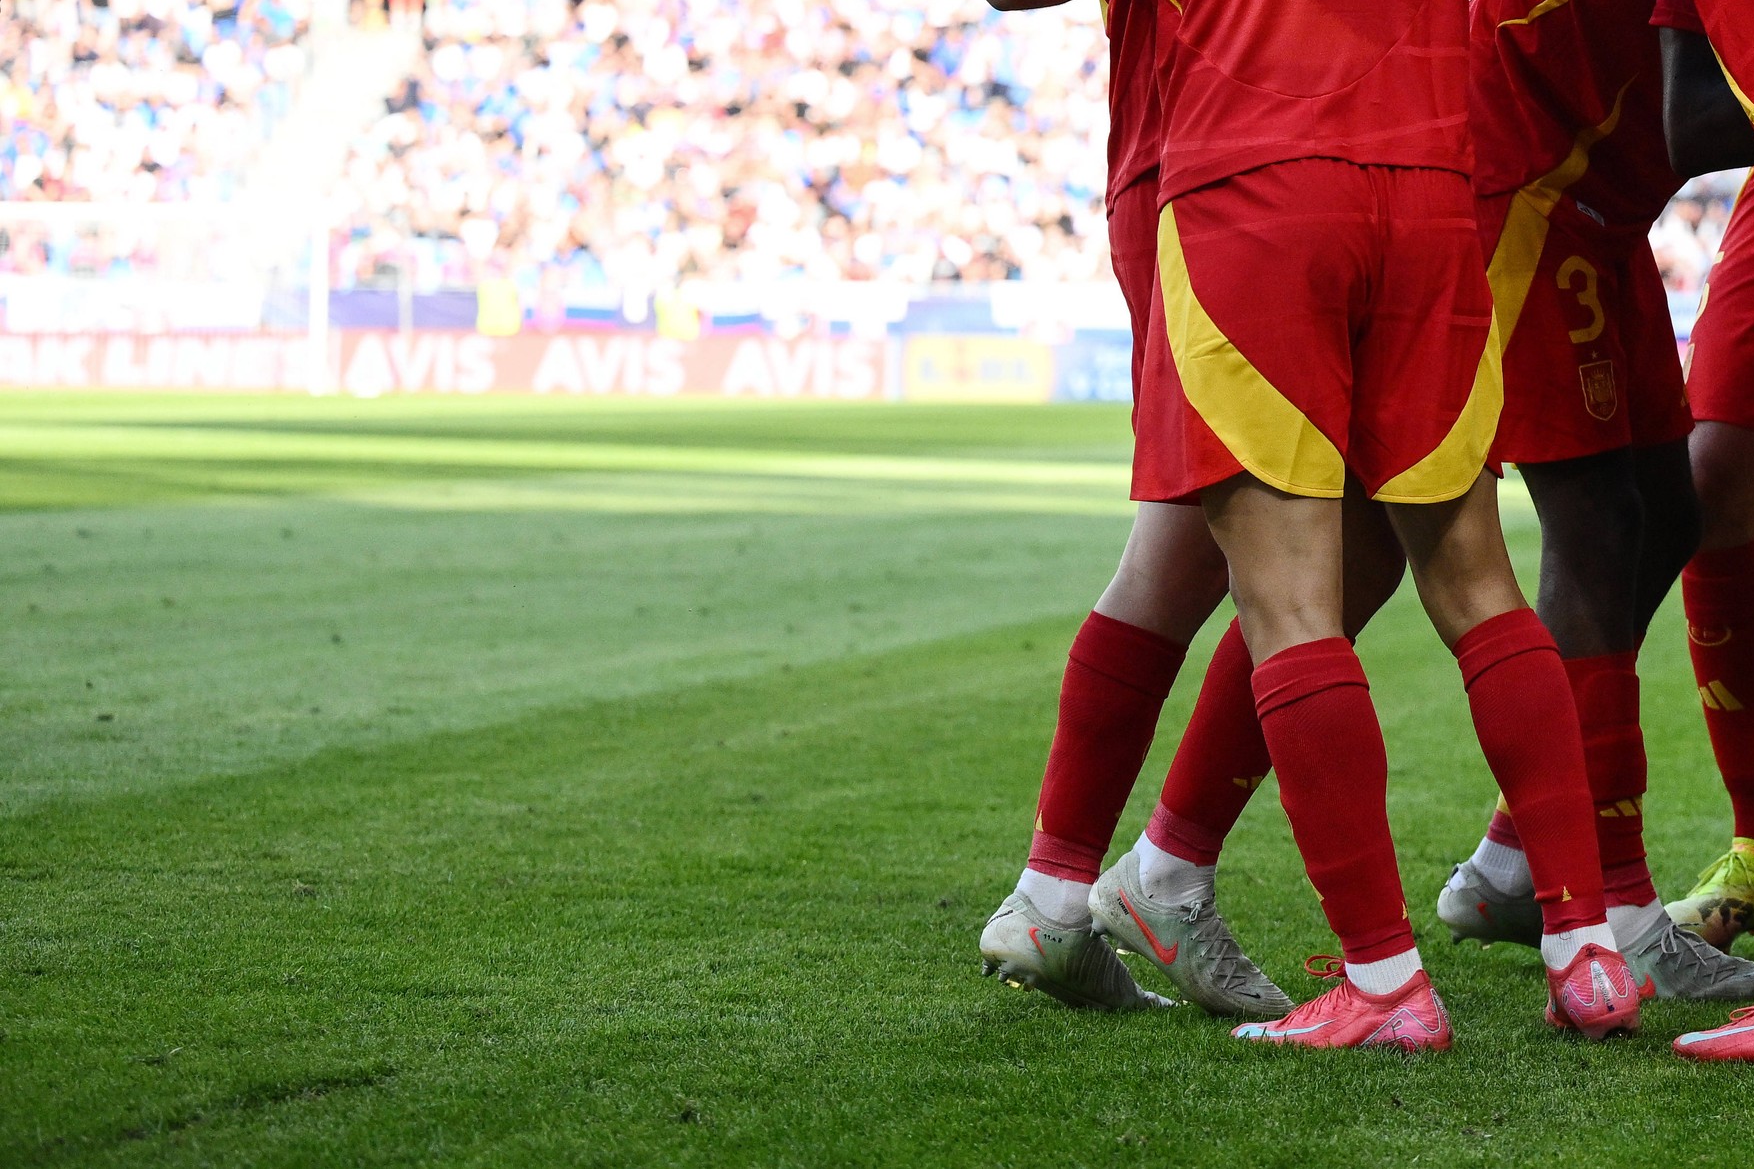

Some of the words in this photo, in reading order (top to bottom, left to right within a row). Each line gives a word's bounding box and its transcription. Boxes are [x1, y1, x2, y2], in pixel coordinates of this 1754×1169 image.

[1556, 255, 1605, 343] 3
[344, 333, 496, 394] AVIS
[532, 336, 684, 395] AVIS
[722, 338, 877, 397] AVIS
